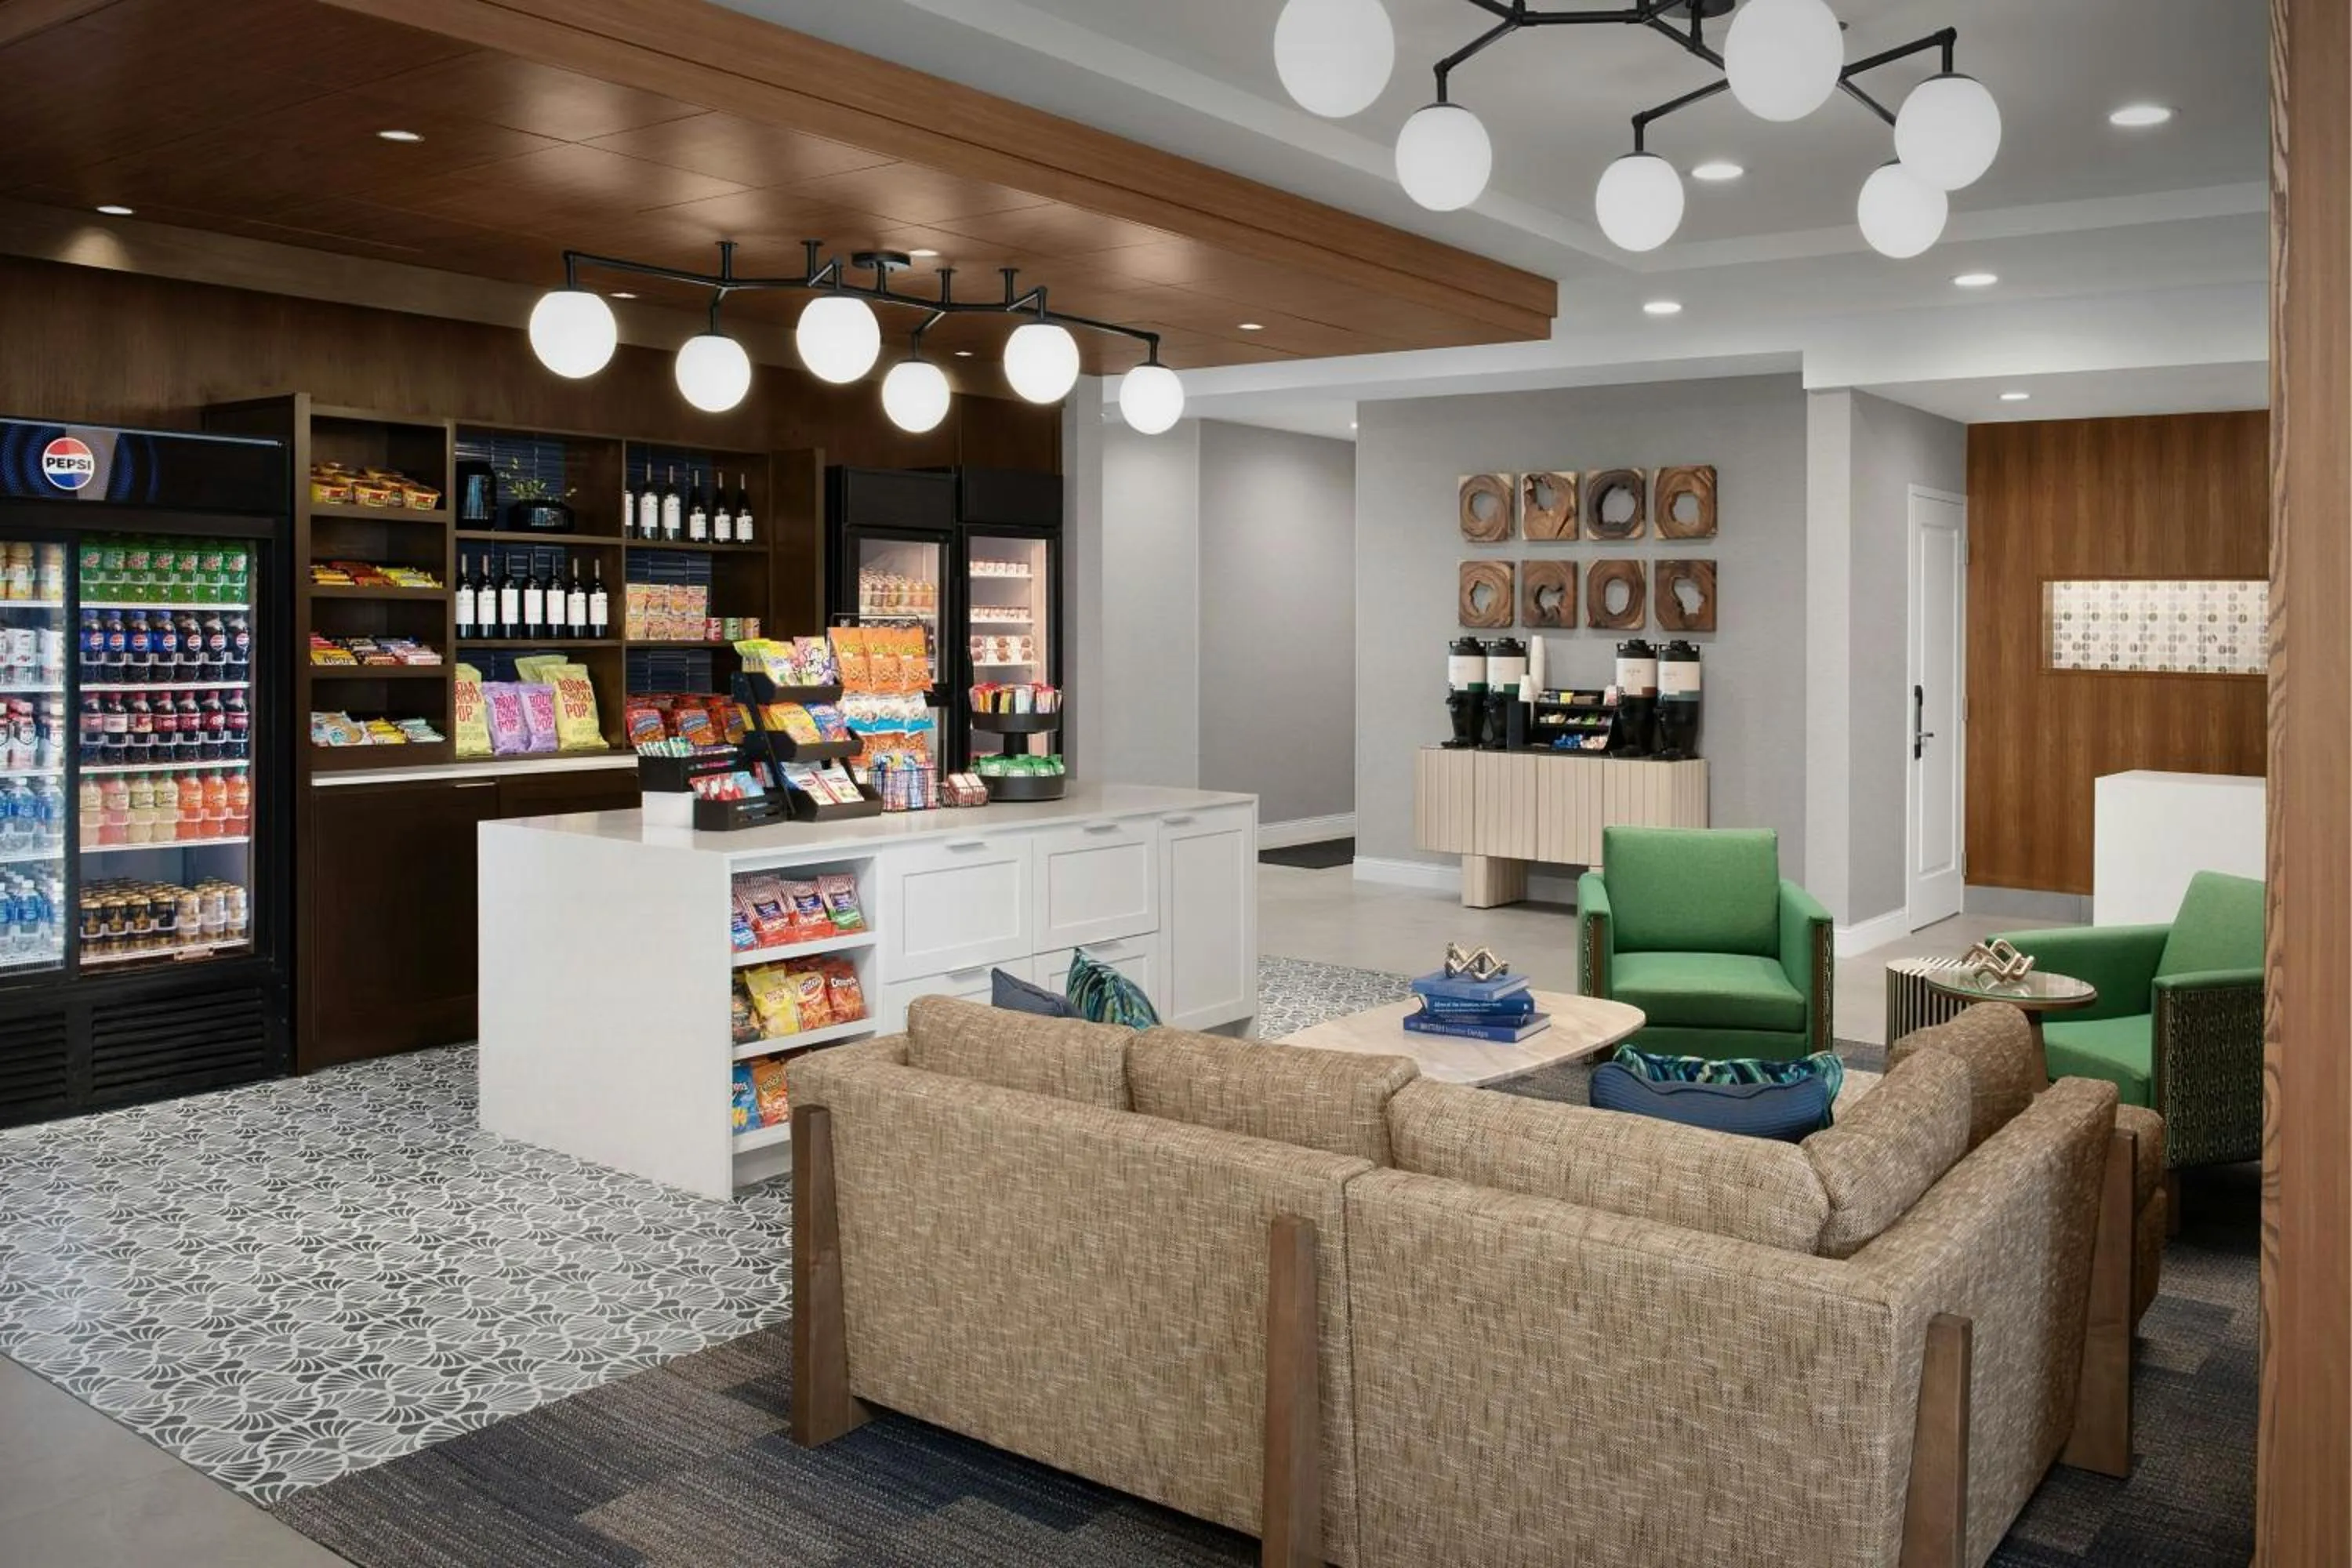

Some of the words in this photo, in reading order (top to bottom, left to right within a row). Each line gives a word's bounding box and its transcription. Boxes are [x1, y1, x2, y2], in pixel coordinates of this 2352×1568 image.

[46, 457, 92, 470] PEPSI
[456, 705, 473, 722] OP
[565, 702, 587, 718] POP
[498, 720, 517, 733] POP
